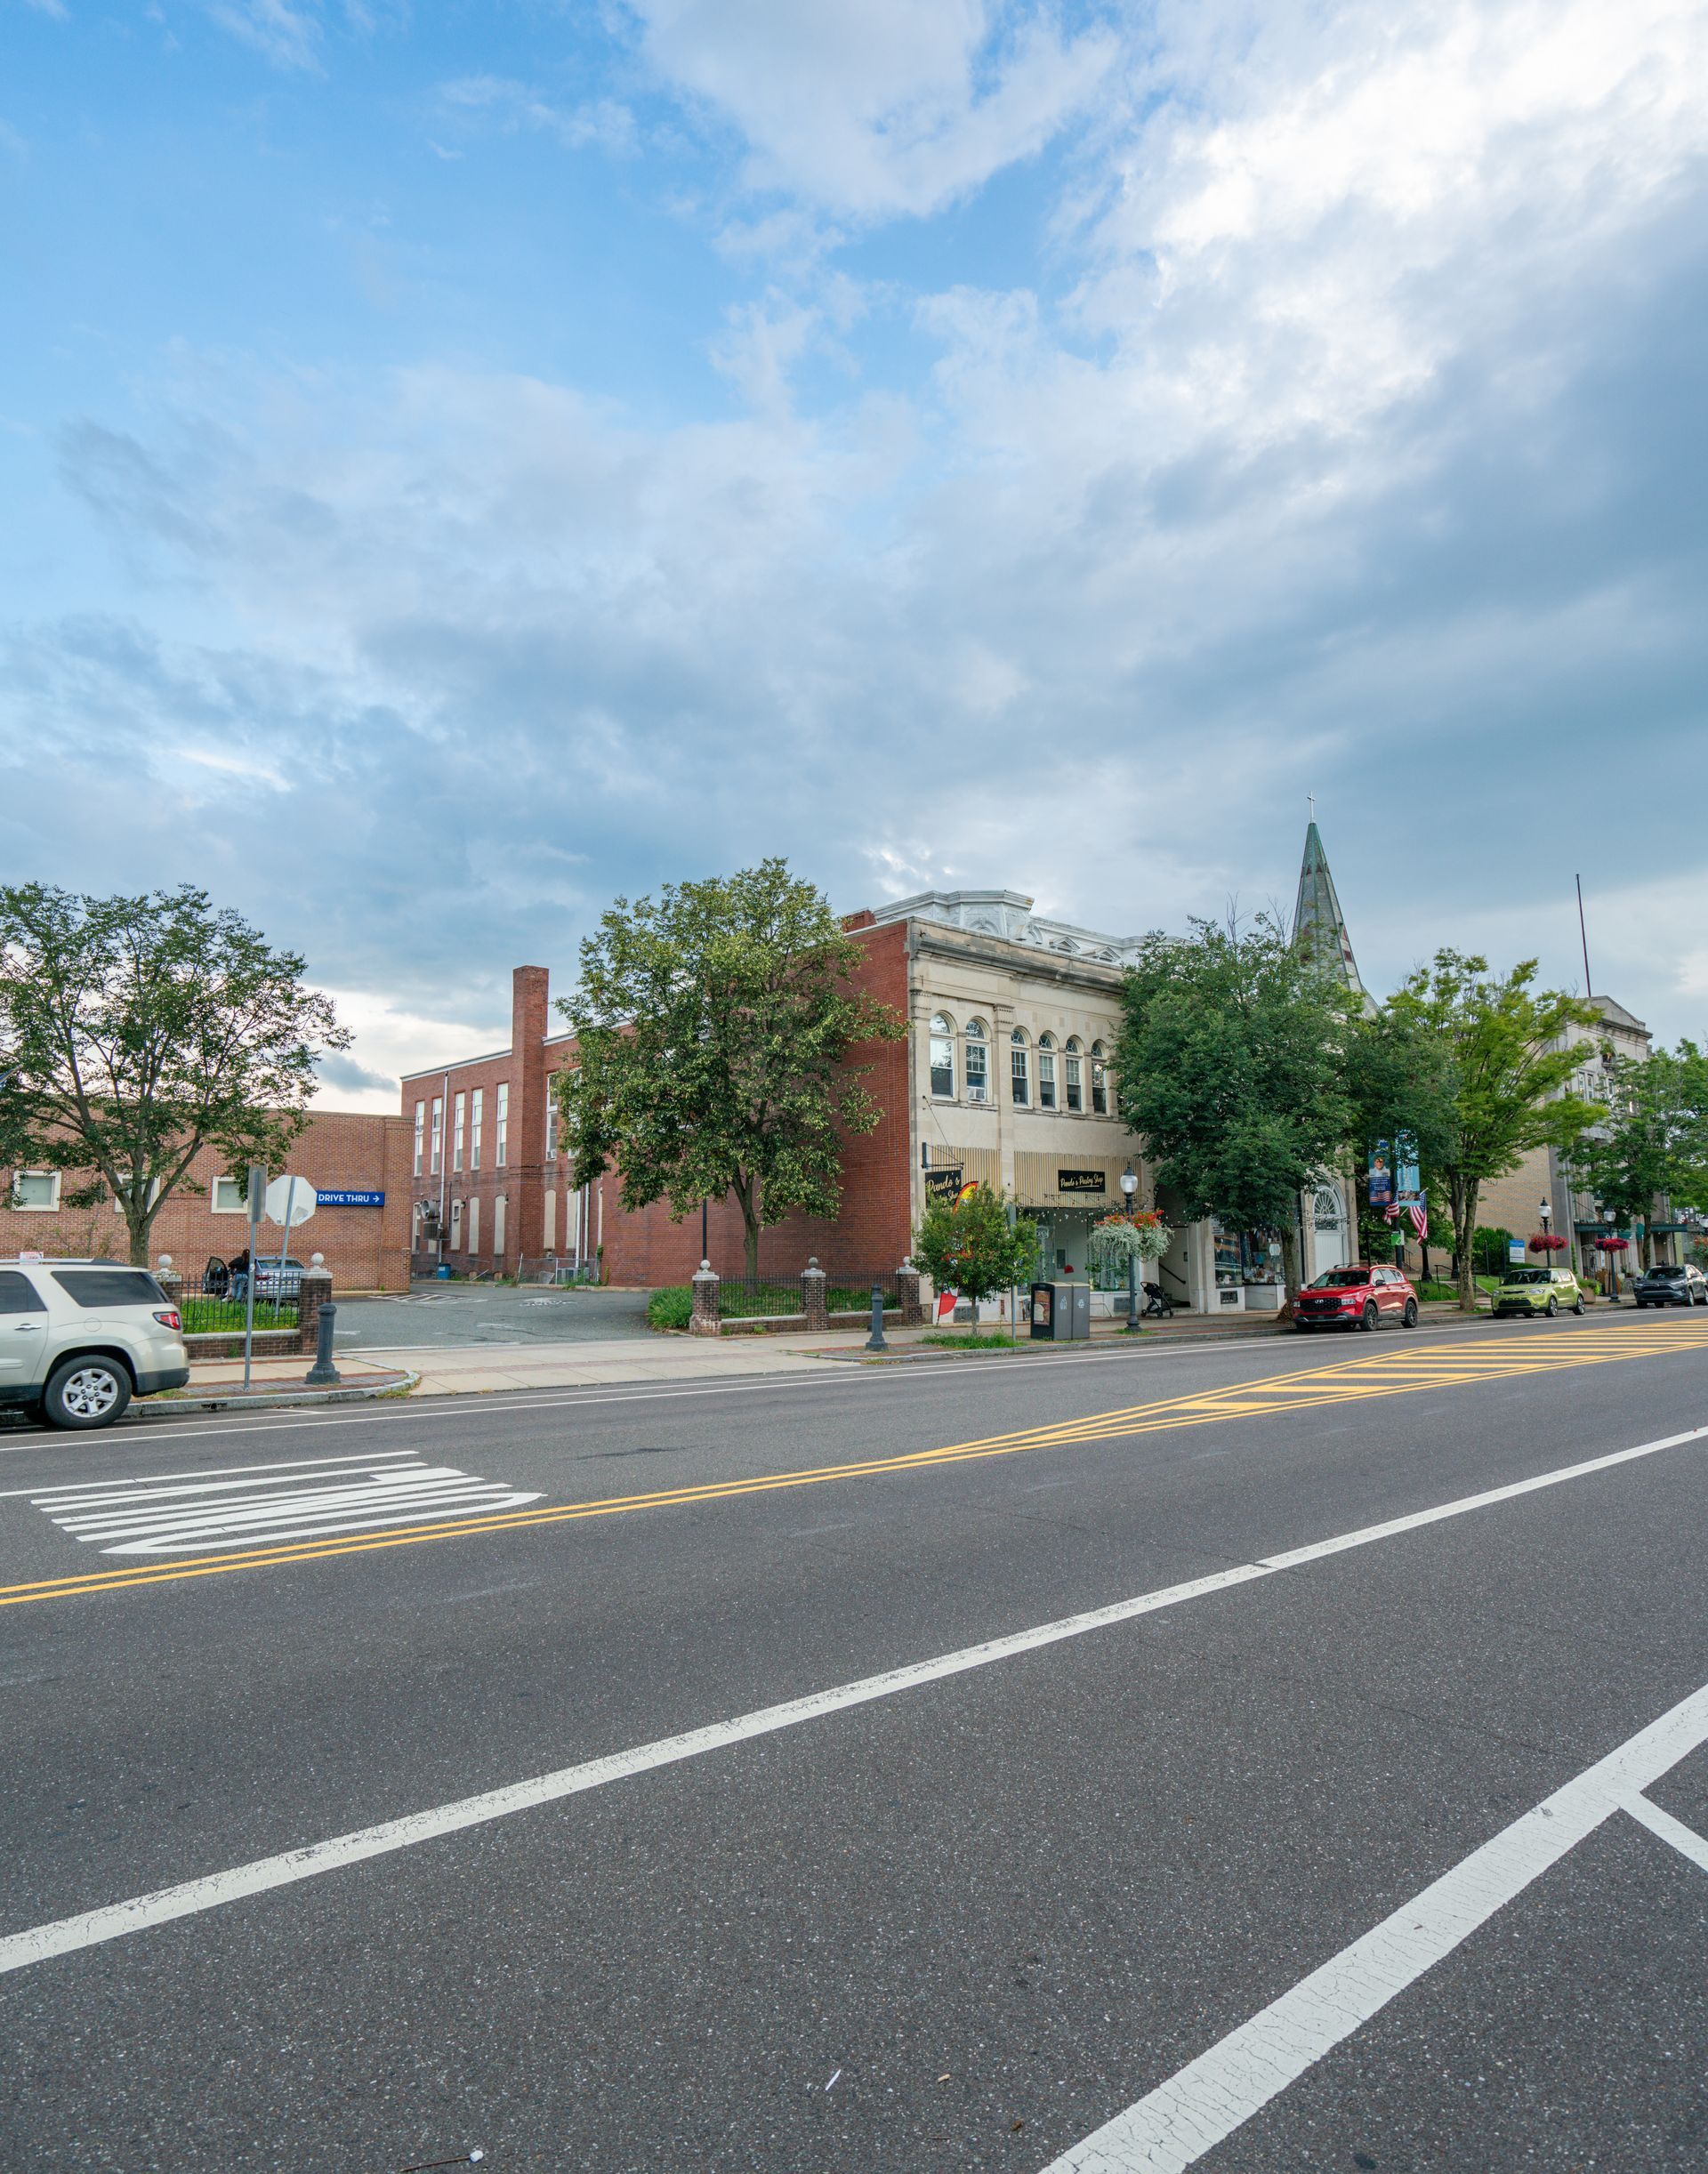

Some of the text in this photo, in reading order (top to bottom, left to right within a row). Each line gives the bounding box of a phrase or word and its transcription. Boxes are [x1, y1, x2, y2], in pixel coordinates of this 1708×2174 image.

[926, 1172, 960, 1194] Pando's
[318, 1194, 369, 1203] DRIVE THRU
